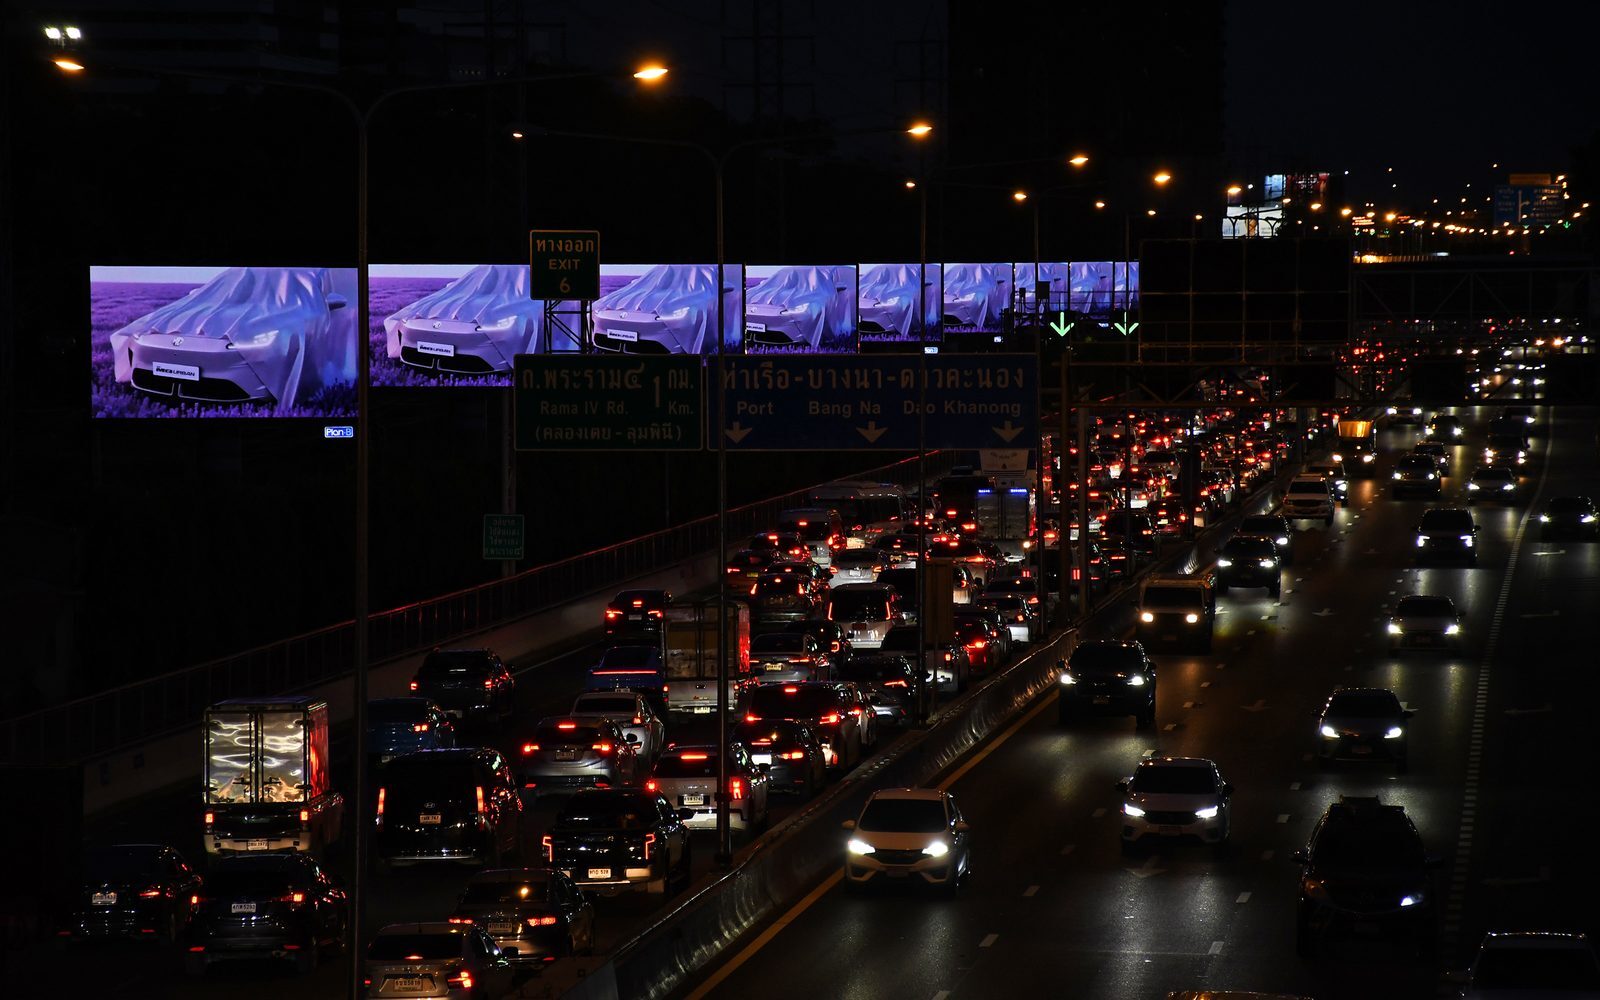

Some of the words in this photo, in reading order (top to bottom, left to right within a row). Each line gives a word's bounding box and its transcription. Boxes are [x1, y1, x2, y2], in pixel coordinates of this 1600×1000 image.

[536, 239, 595, 253] ทางออก
[548, 258, 581, 270] EXIT
[559, 276, 571, 293] 6
[667, 368, 694, 389] กม.
[652, 375, 662, 408] 1
[540, 400, 578, 415] Rama
[584, 400, 599, 415] IV
[606, 400, 629, 415] Rd.
[668, 401, 694, 415] Km.
[736, 400, 775, 415] Port
[808, 400, 852, 418] Bang
[859, 400, 881, 415] Na
[944, 400, 1021, 417] Khanong
